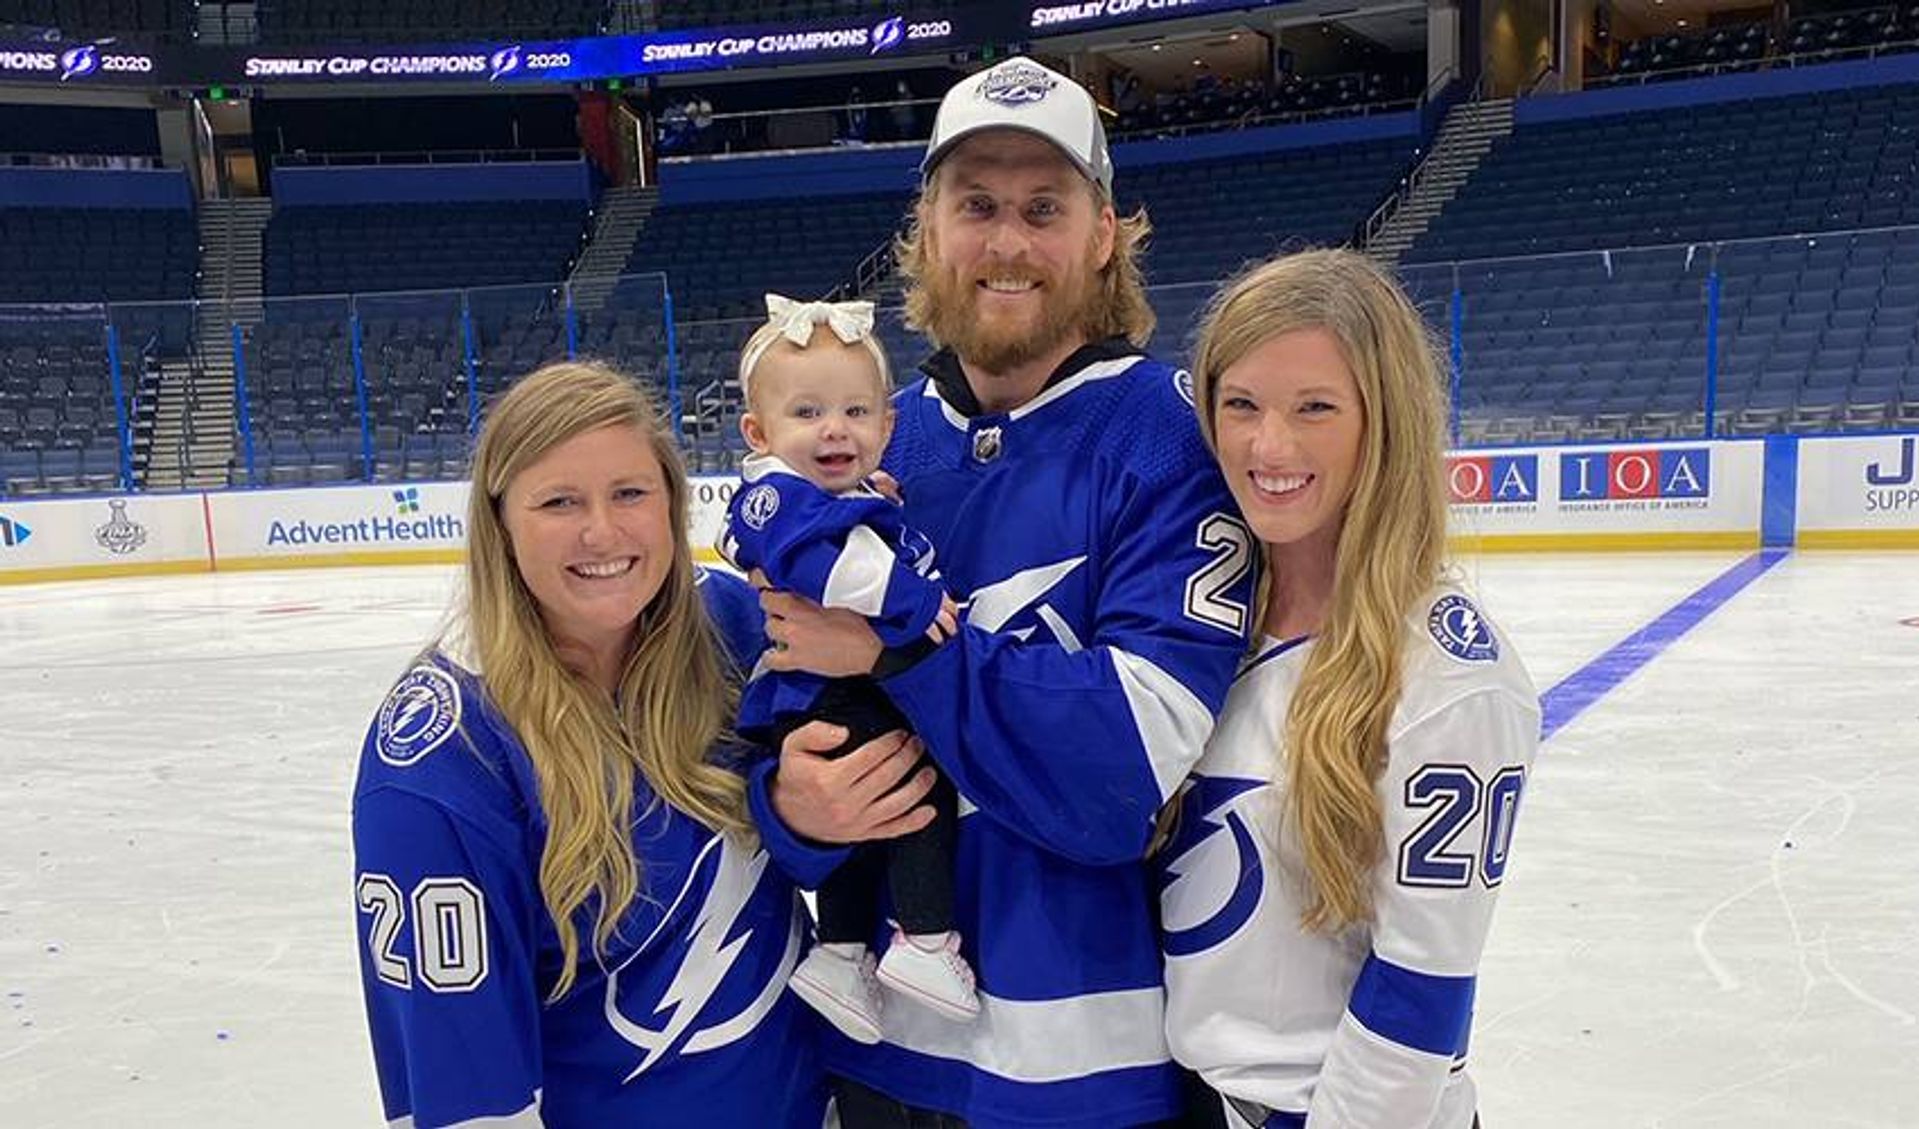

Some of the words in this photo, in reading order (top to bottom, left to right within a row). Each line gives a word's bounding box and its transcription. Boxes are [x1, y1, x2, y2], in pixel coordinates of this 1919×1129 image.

[1030, 1, 1103, 27] STANLEY
[642, 40, 716, 62] STANLEY
[717, 38, 755, 55] CUP
[757, 28, 867, 53] CHAMPIONS
[907, 21, 951, 39] 2020
[101, 55, 152, 72] 2020
[245, 57, 327, 76] STANLEY
[327, 57, 369, 74] CUP
[369, 55, 487, 74] CHAMPIONS
[526, 53, 571, 69] 2020
[1576, 454, 1702, 495] IOA
[1665, 501, 1708, 509] AMERICA
[1183, 511, 1252, 638] 2
[1396, 763, 1526, 889] 20
[356, 872, 489, 993] 20
